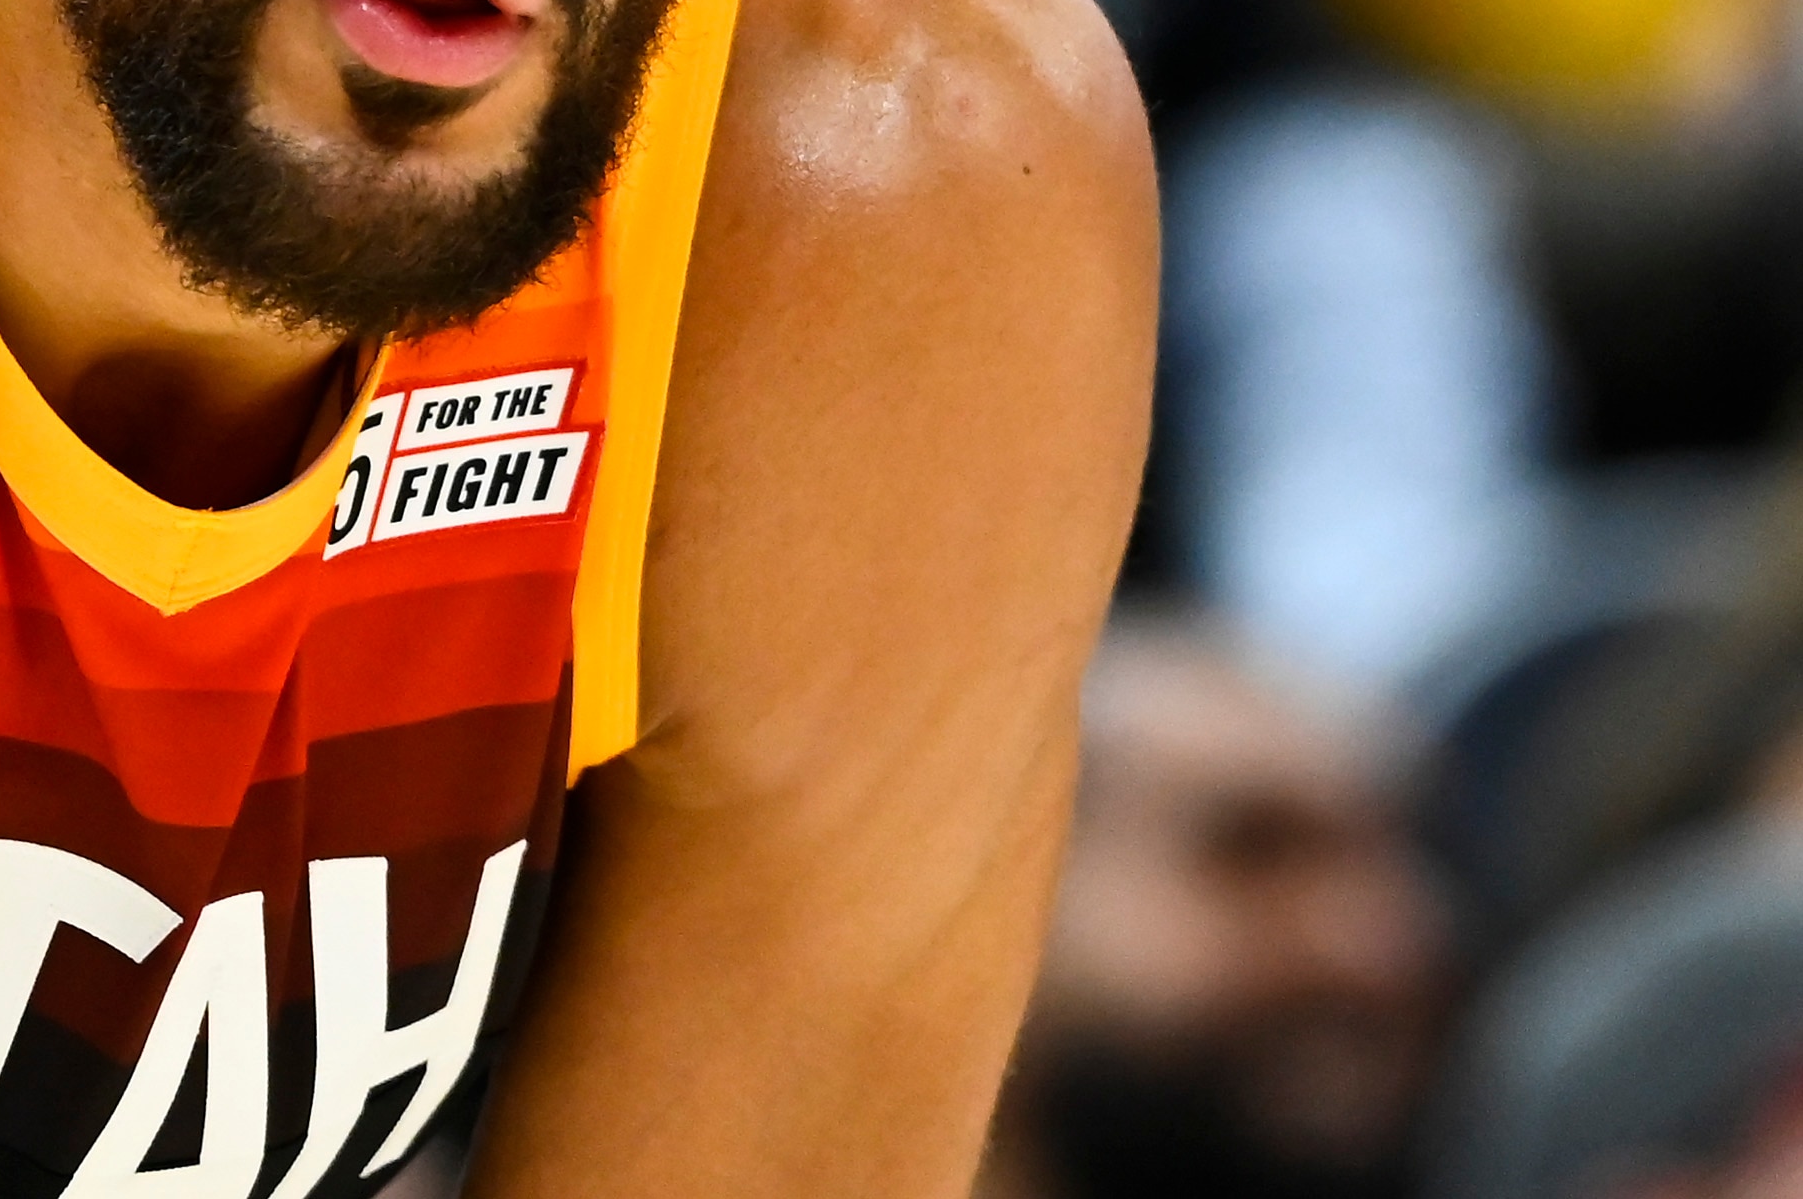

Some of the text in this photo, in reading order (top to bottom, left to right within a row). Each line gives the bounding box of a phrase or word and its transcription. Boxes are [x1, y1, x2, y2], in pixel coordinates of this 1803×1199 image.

[416, 384, 553, 433] FOR THE
[390, 447, 568, 524] FIGHT
